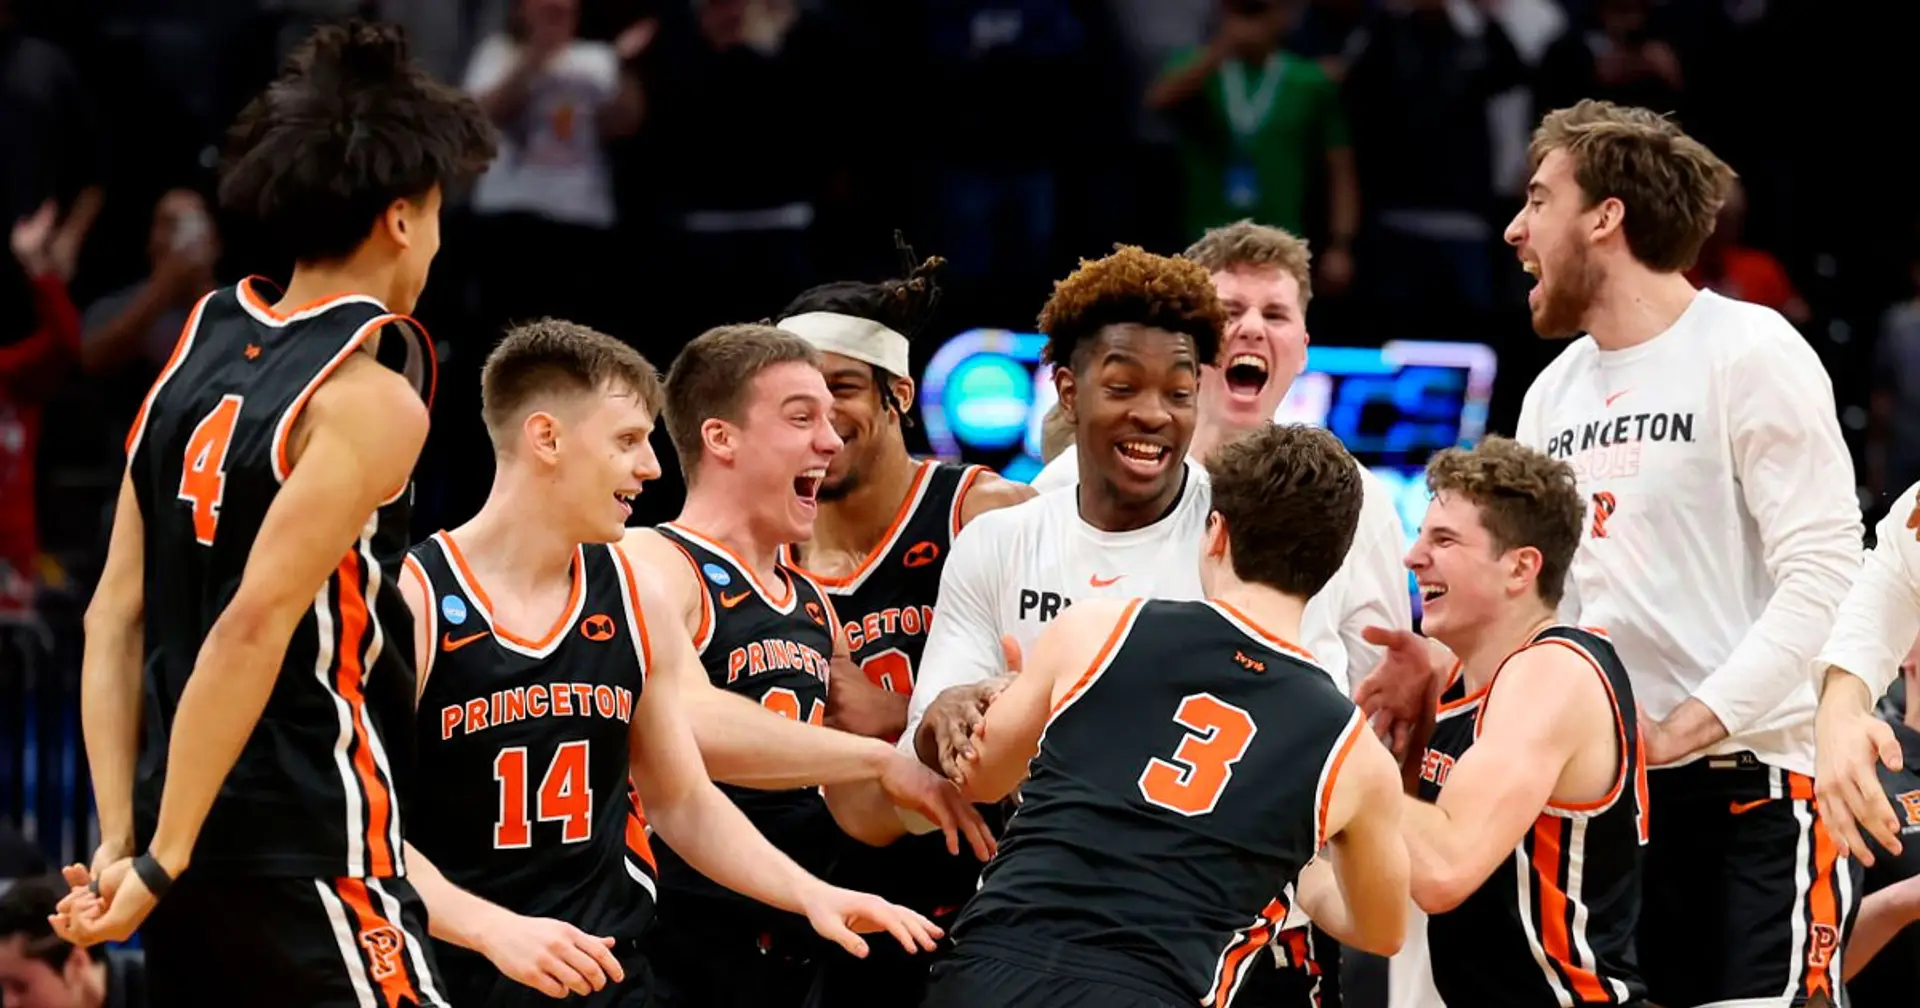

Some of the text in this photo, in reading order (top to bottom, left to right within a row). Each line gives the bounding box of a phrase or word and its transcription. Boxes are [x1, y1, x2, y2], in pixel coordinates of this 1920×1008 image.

[177, 393, 244, 546] 4
[1591, 491, 1616, 539] P
[441, 683, 633, 740] PRINCETON
[1137, 692, 1258, 817] 3
[493, 739, 593, 850] 14
[358, 926, 404, 982] P
[1808, 923, 1838, 967] P
